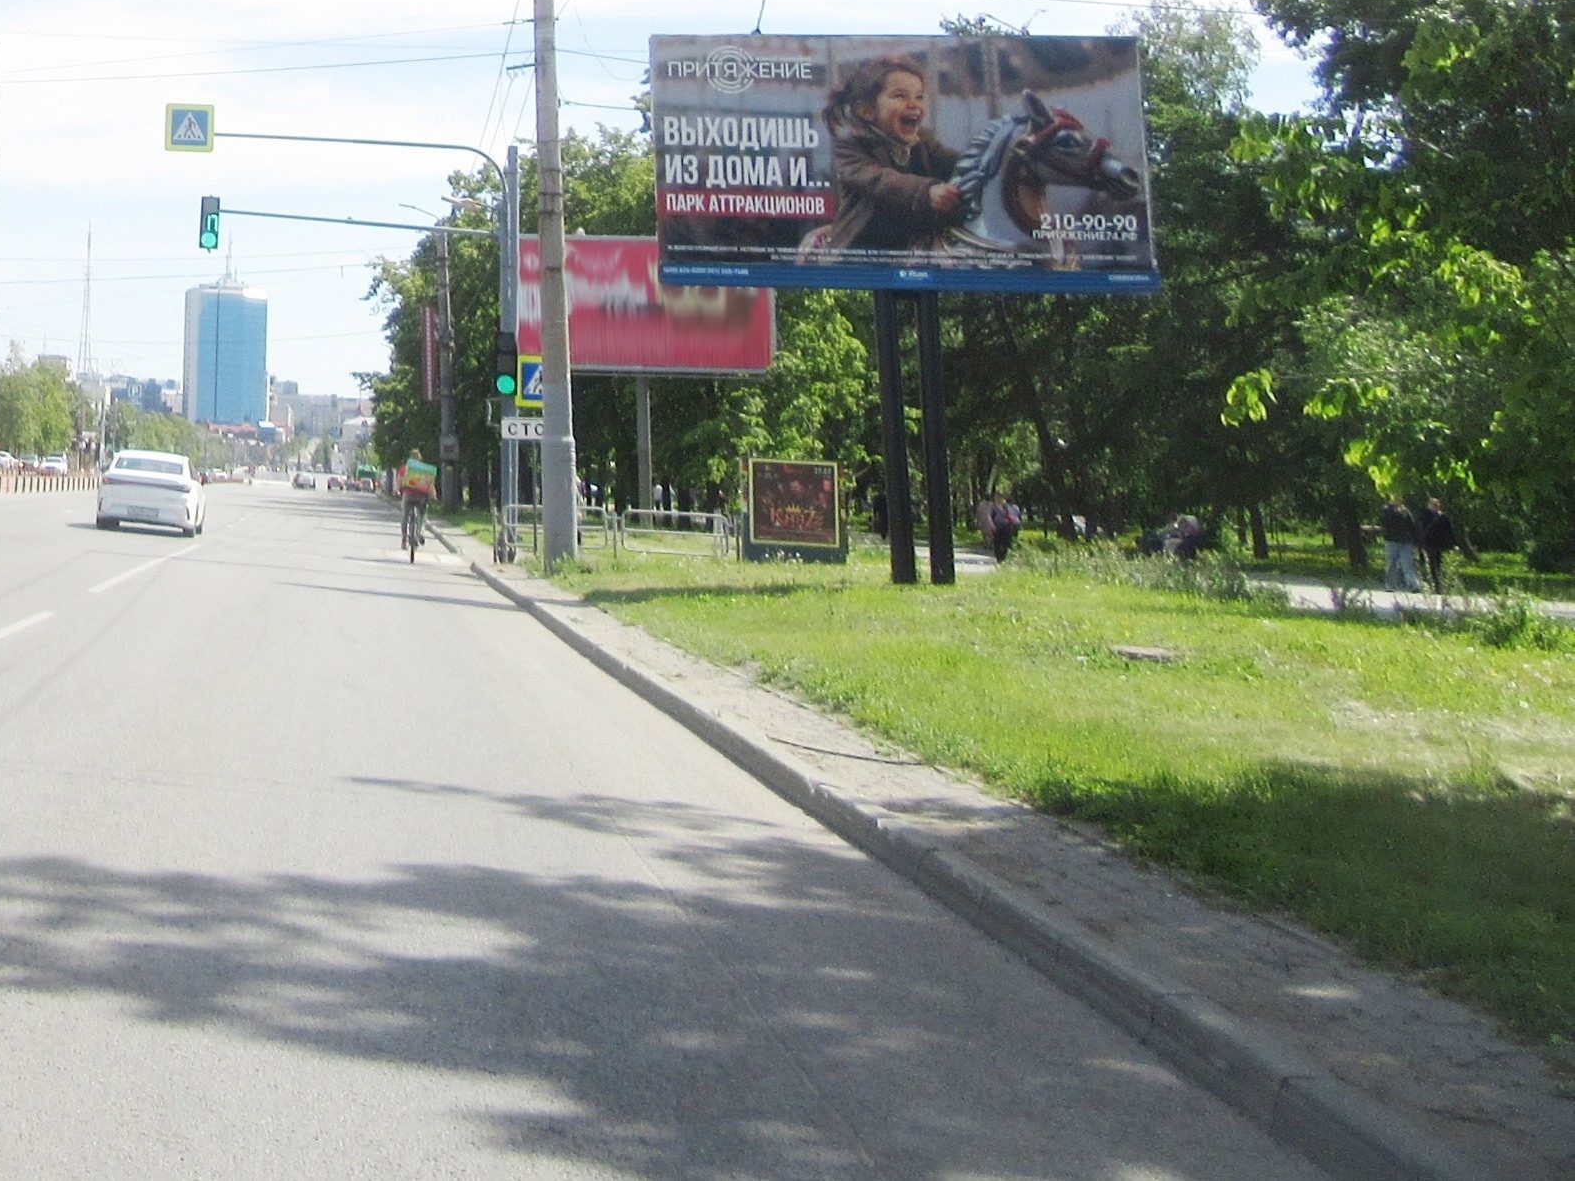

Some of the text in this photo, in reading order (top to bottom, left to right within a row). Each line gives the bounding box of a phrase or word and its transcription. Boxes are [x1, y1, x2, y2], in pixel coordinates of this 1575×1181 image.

[668, 60, 813, 79] ПРИТЯЖЕНИЕ
[663, 116, 820, 149] ВЫХОДИШЬ
[664, 154, 831, 188] ИЗ ДОМА И...
[666, 193, 825, 215] ПАРК АТТРАКЦИОНОВ
[1040, 213, 1137, 232] 210-90-90
[507, 422, 545, 436] СТО
